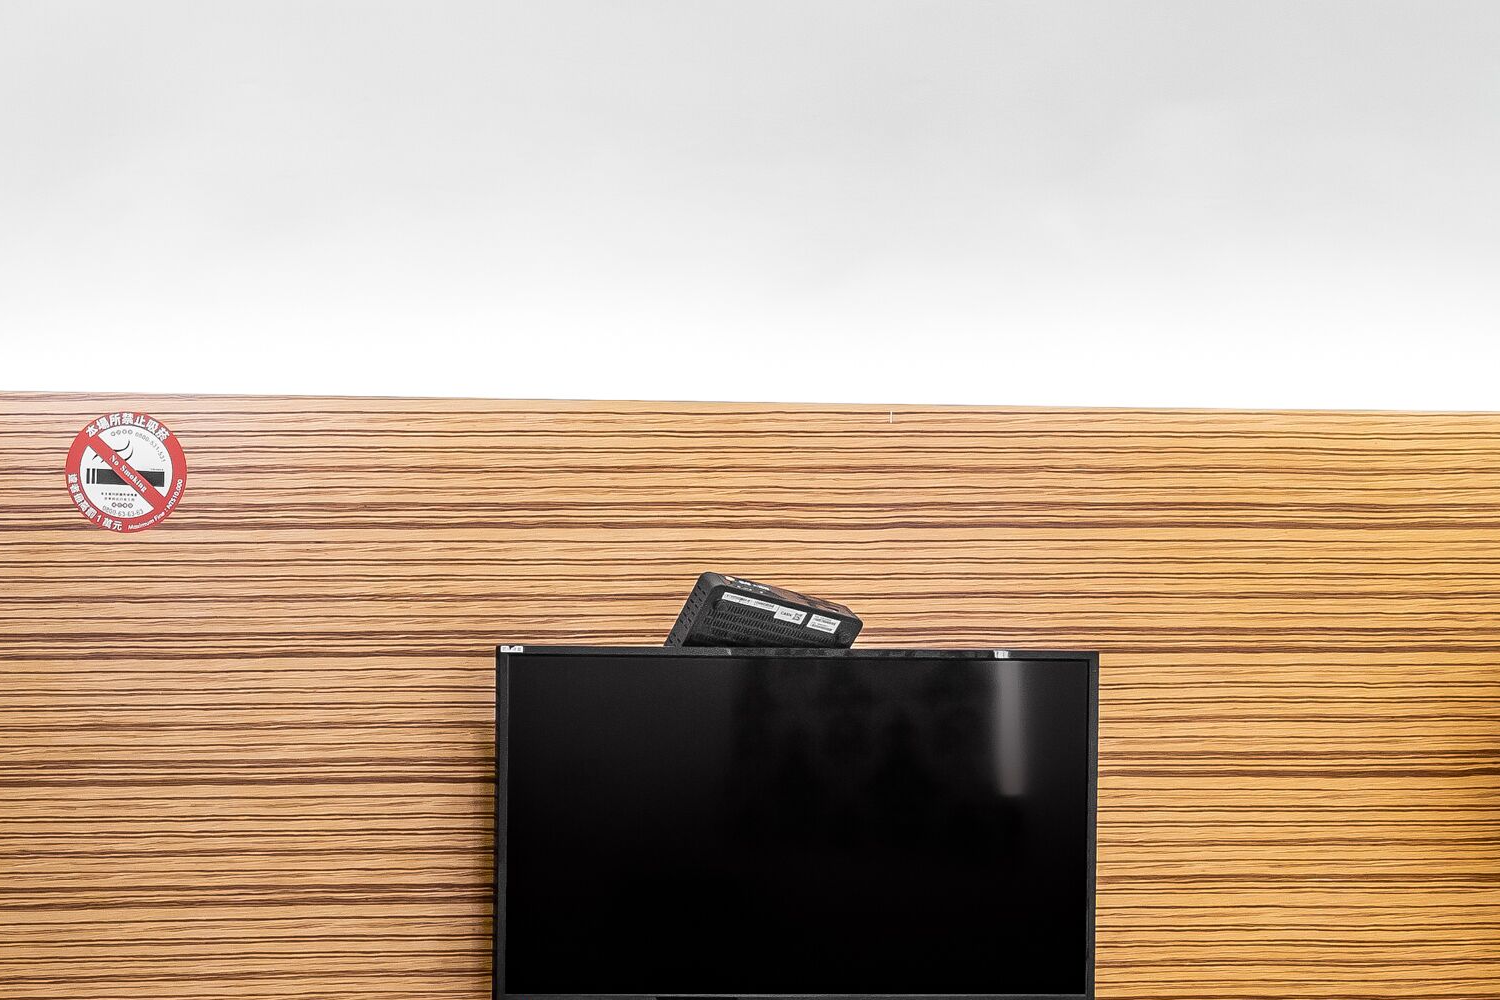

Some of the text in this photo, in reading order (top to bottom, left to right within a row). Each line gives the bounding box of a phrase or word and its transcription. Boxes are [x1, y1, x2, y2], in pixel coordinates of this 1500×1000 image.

[109, 455, 147, 493] No Smoking
[128, 518, 155, 530] Maximum
